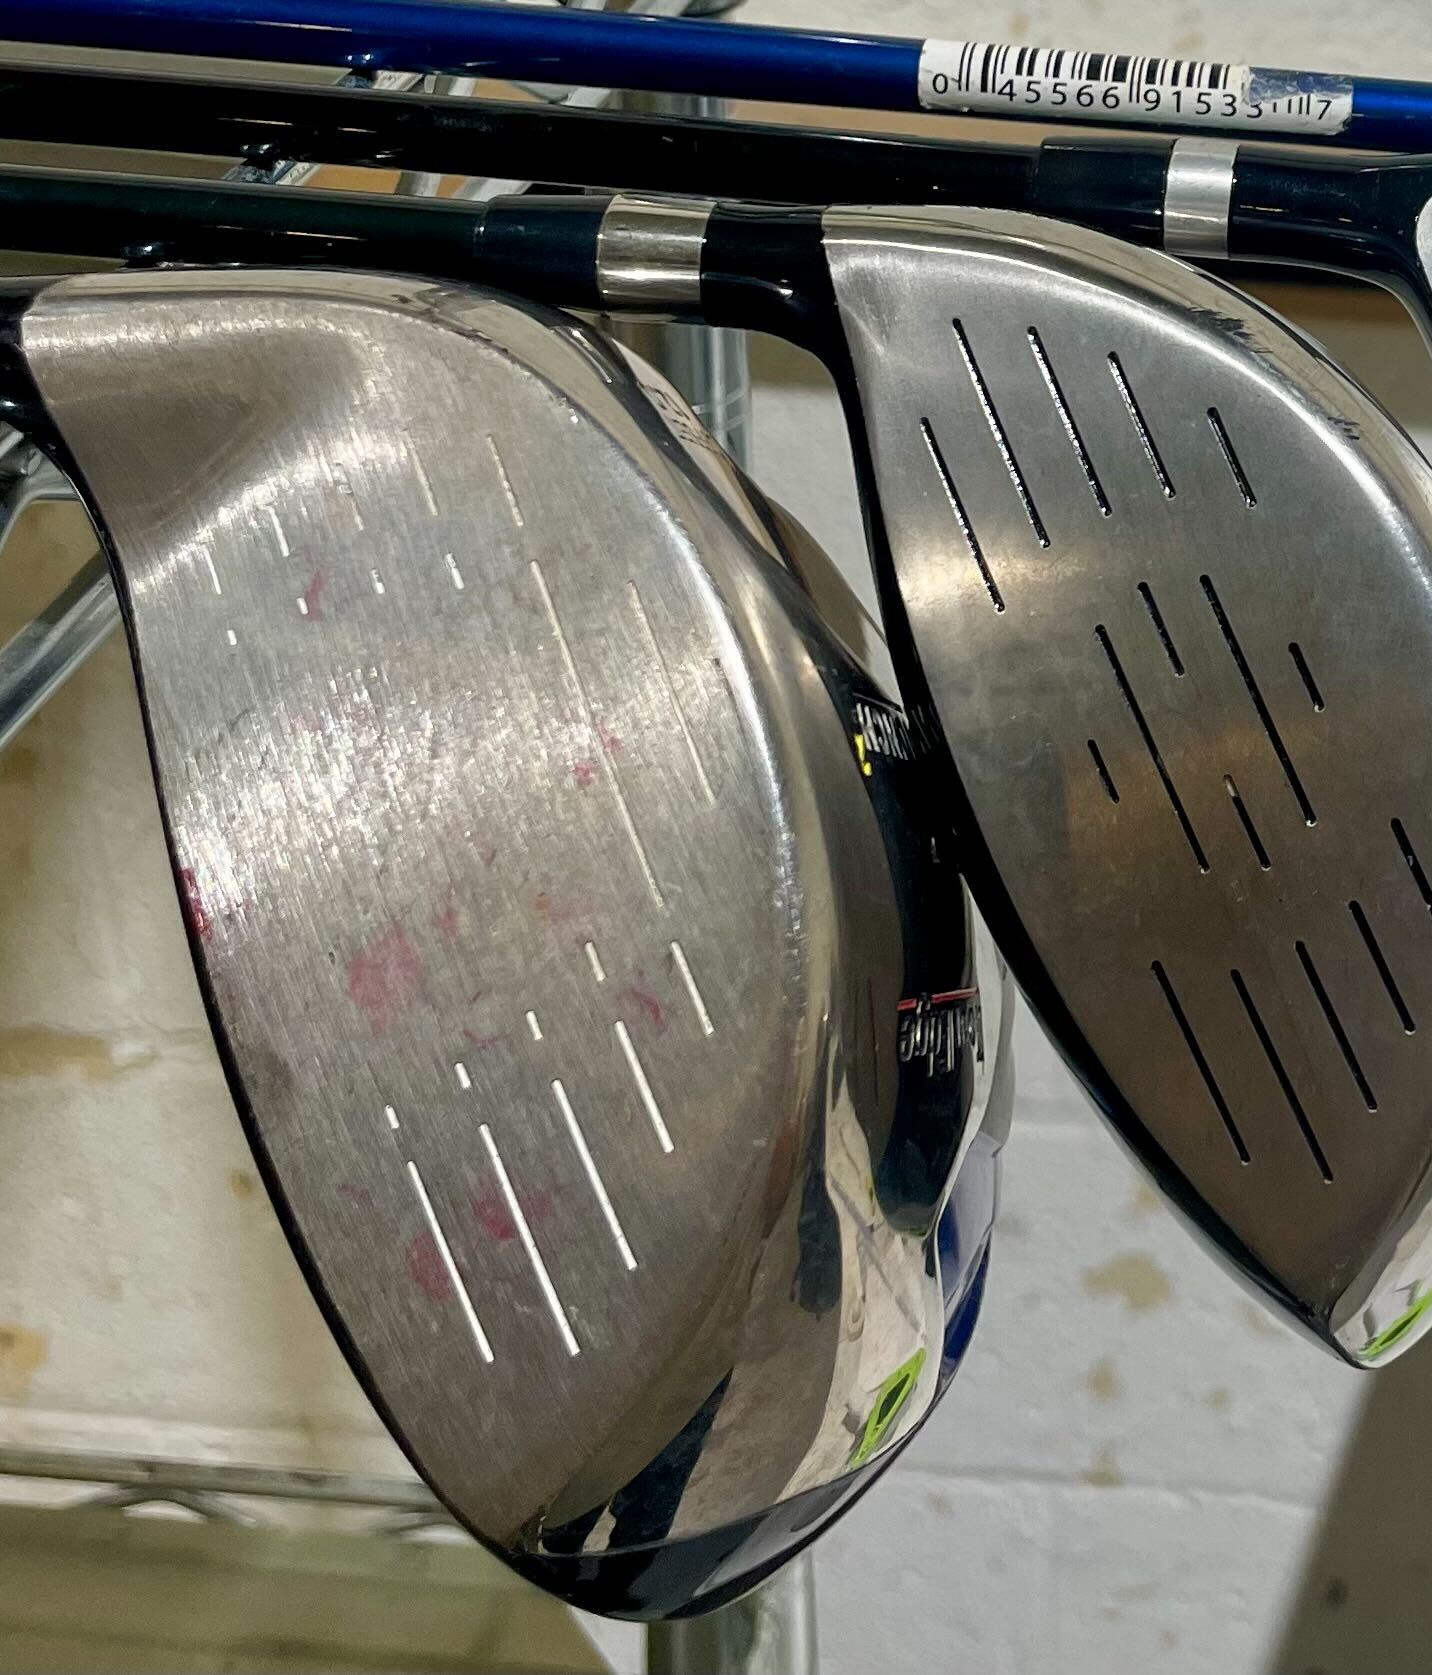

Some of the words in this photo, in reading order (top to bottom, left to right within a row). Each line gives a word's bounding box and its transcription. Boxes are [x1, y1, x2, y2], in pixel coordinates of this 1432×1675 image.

[932, 73, 949, 94] 0
[998, 78, 1120, 110] 45566
[1317, 99, 1332, 121] 7
